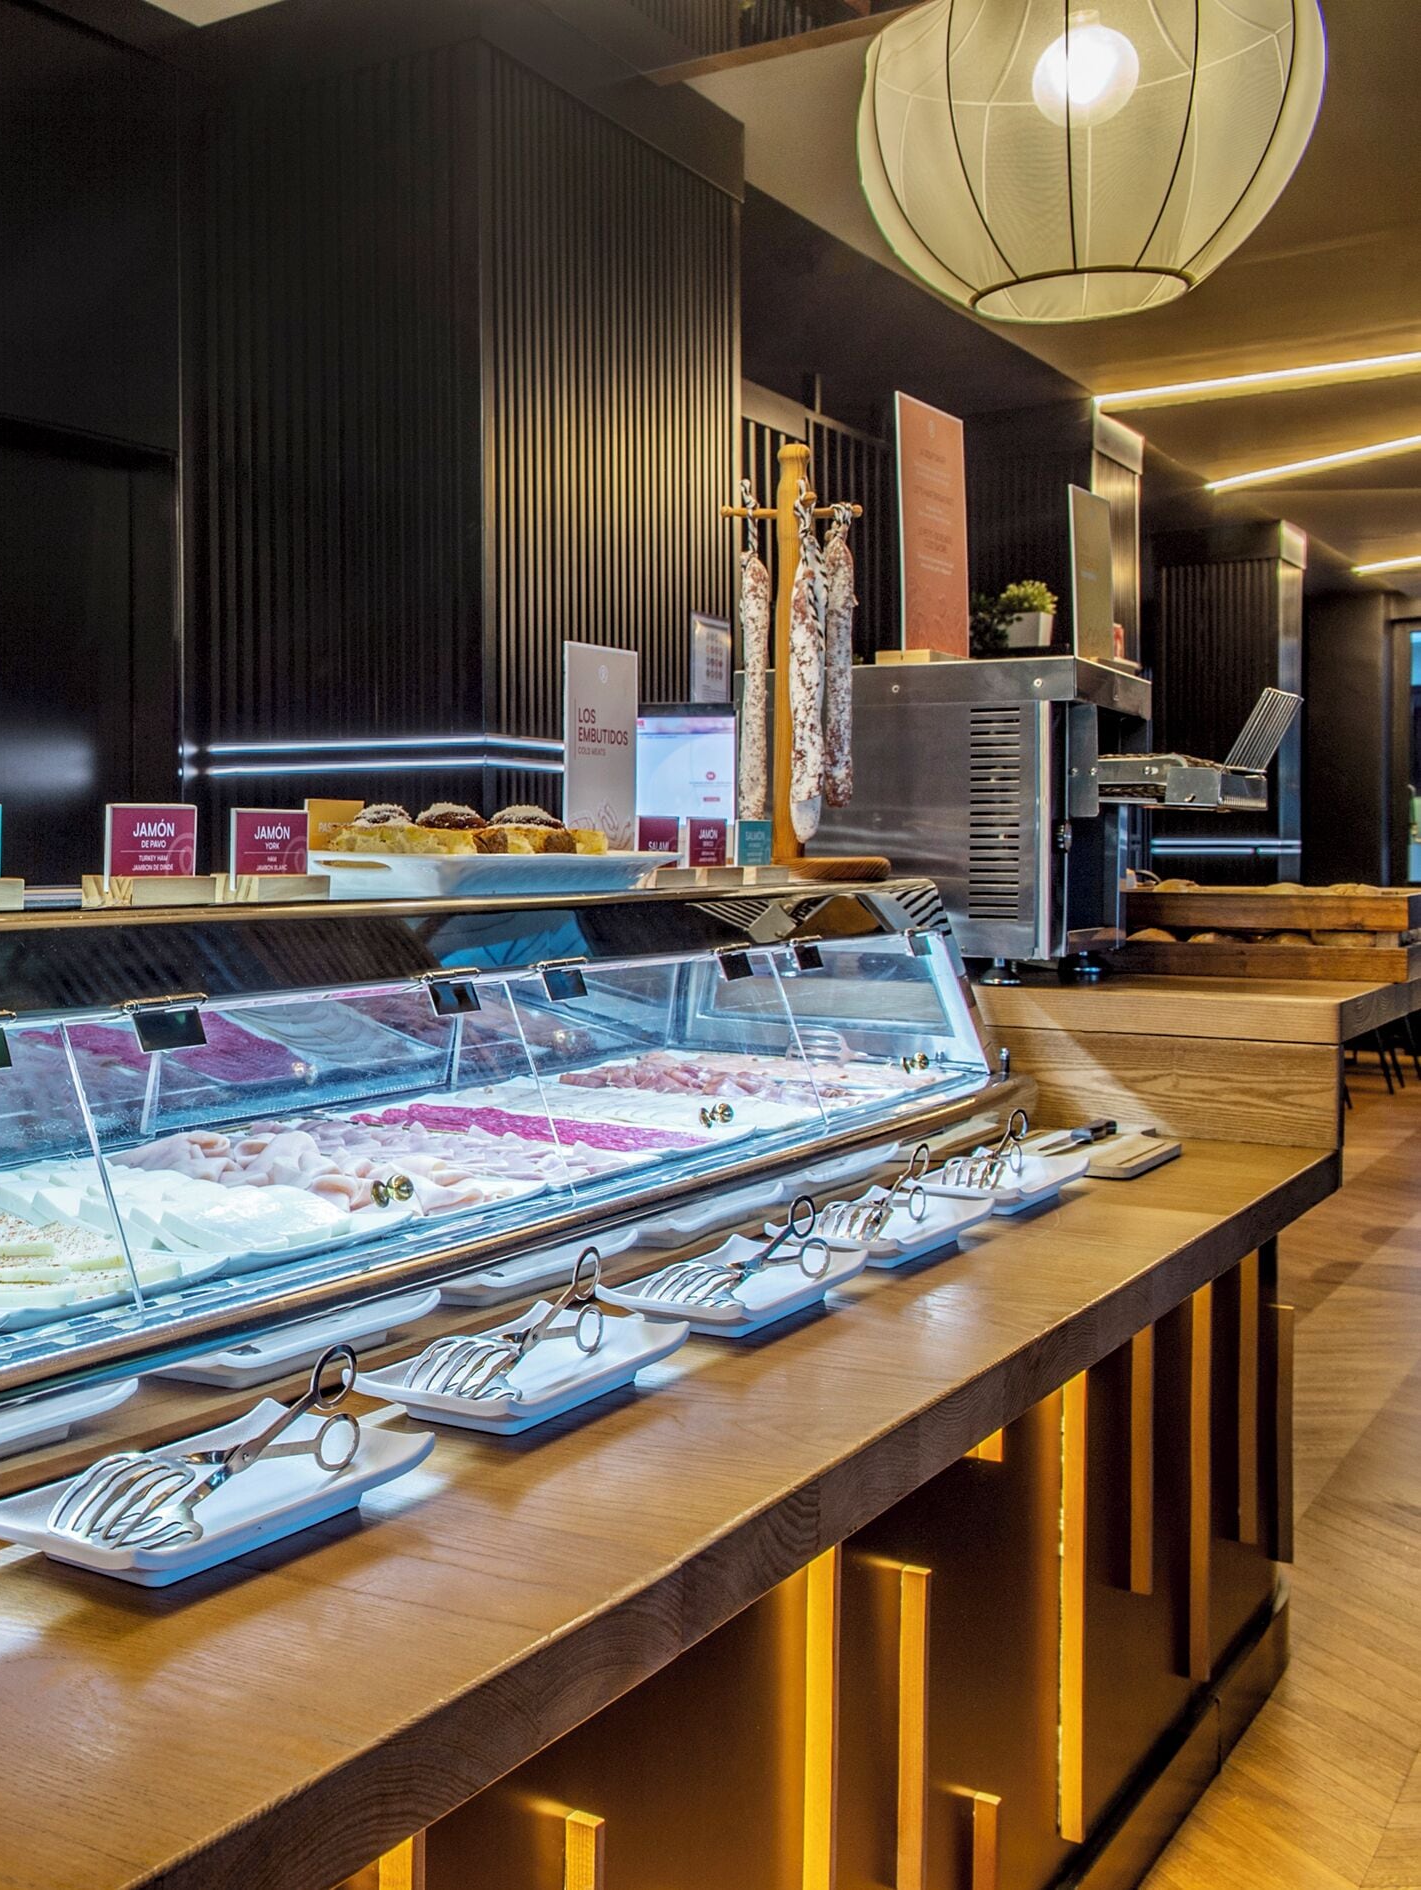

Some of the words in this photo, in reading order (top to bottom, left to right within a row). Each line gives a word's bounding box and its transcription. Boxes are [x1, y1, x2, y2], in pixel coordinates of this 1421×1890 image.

[578, 707, 596, 724] LOS
[578, 726, 629, 746] EMBUTIDOS
[133, 819, 175, 837] JAMÓN
[254, 822, 290, 840] JAMÓN
[141, 840, 150, 849] DE
[150, 840, 167, 849] PAVO
[265, 842, 280, 850] YORK
